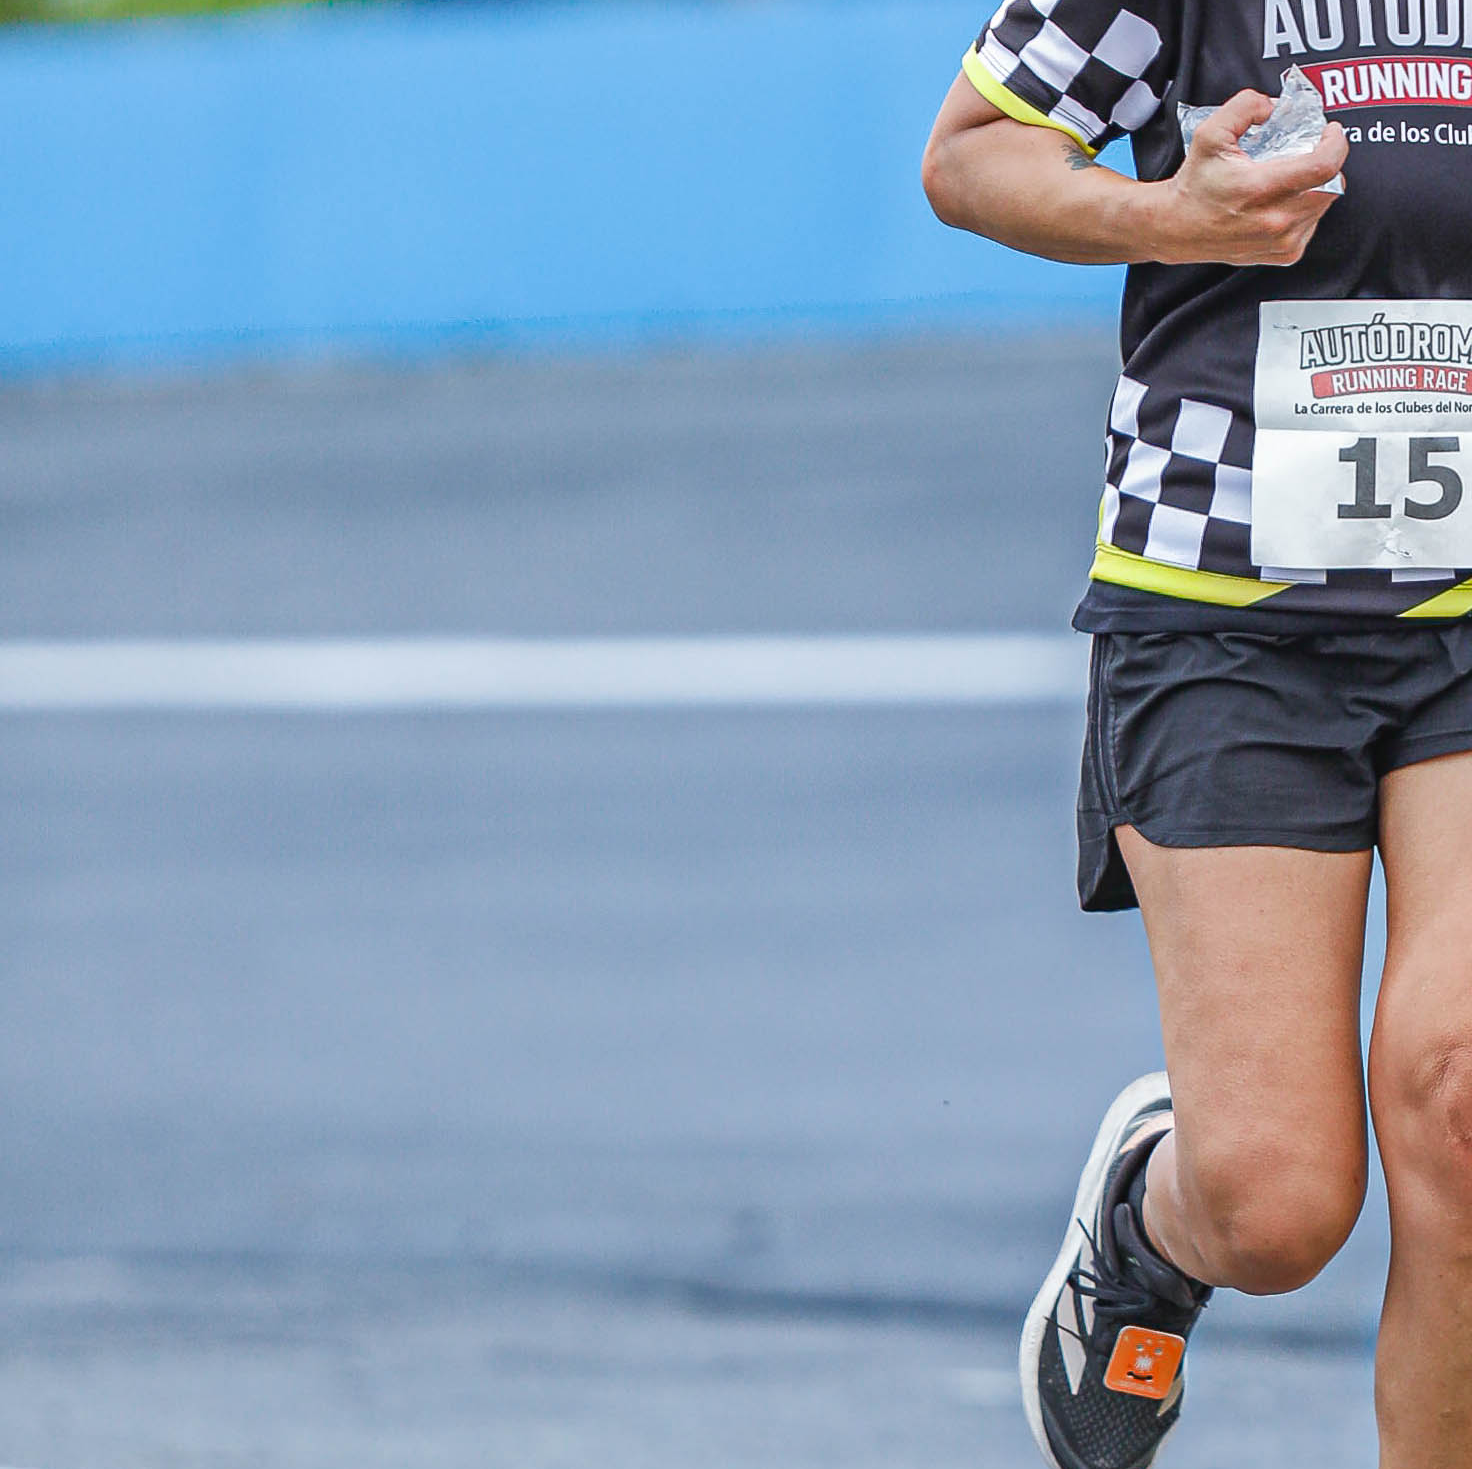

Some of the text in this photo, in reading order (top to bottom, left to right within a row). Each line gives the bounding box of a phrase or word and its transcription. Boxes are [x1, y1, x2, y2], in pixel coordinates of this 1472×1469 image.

[1320, 62, 1472, 109] RUNNING
[1367, 121, 1396, 142] de
[1400, 121, 1431, 143] los
[1331, 367, 1468, 394] RUNNING RACE
[1294, 402, 1308, 415] La
[1310, 402, 1354, 415] Carrera
[1356, 401, 1373, 414] de
[1375, 401, 1392, 414] los
[1394, 401, 1433, 414] Clubes
[1435, 400, 1452, 414] del
[1337, 436, 1464, 521] 15
